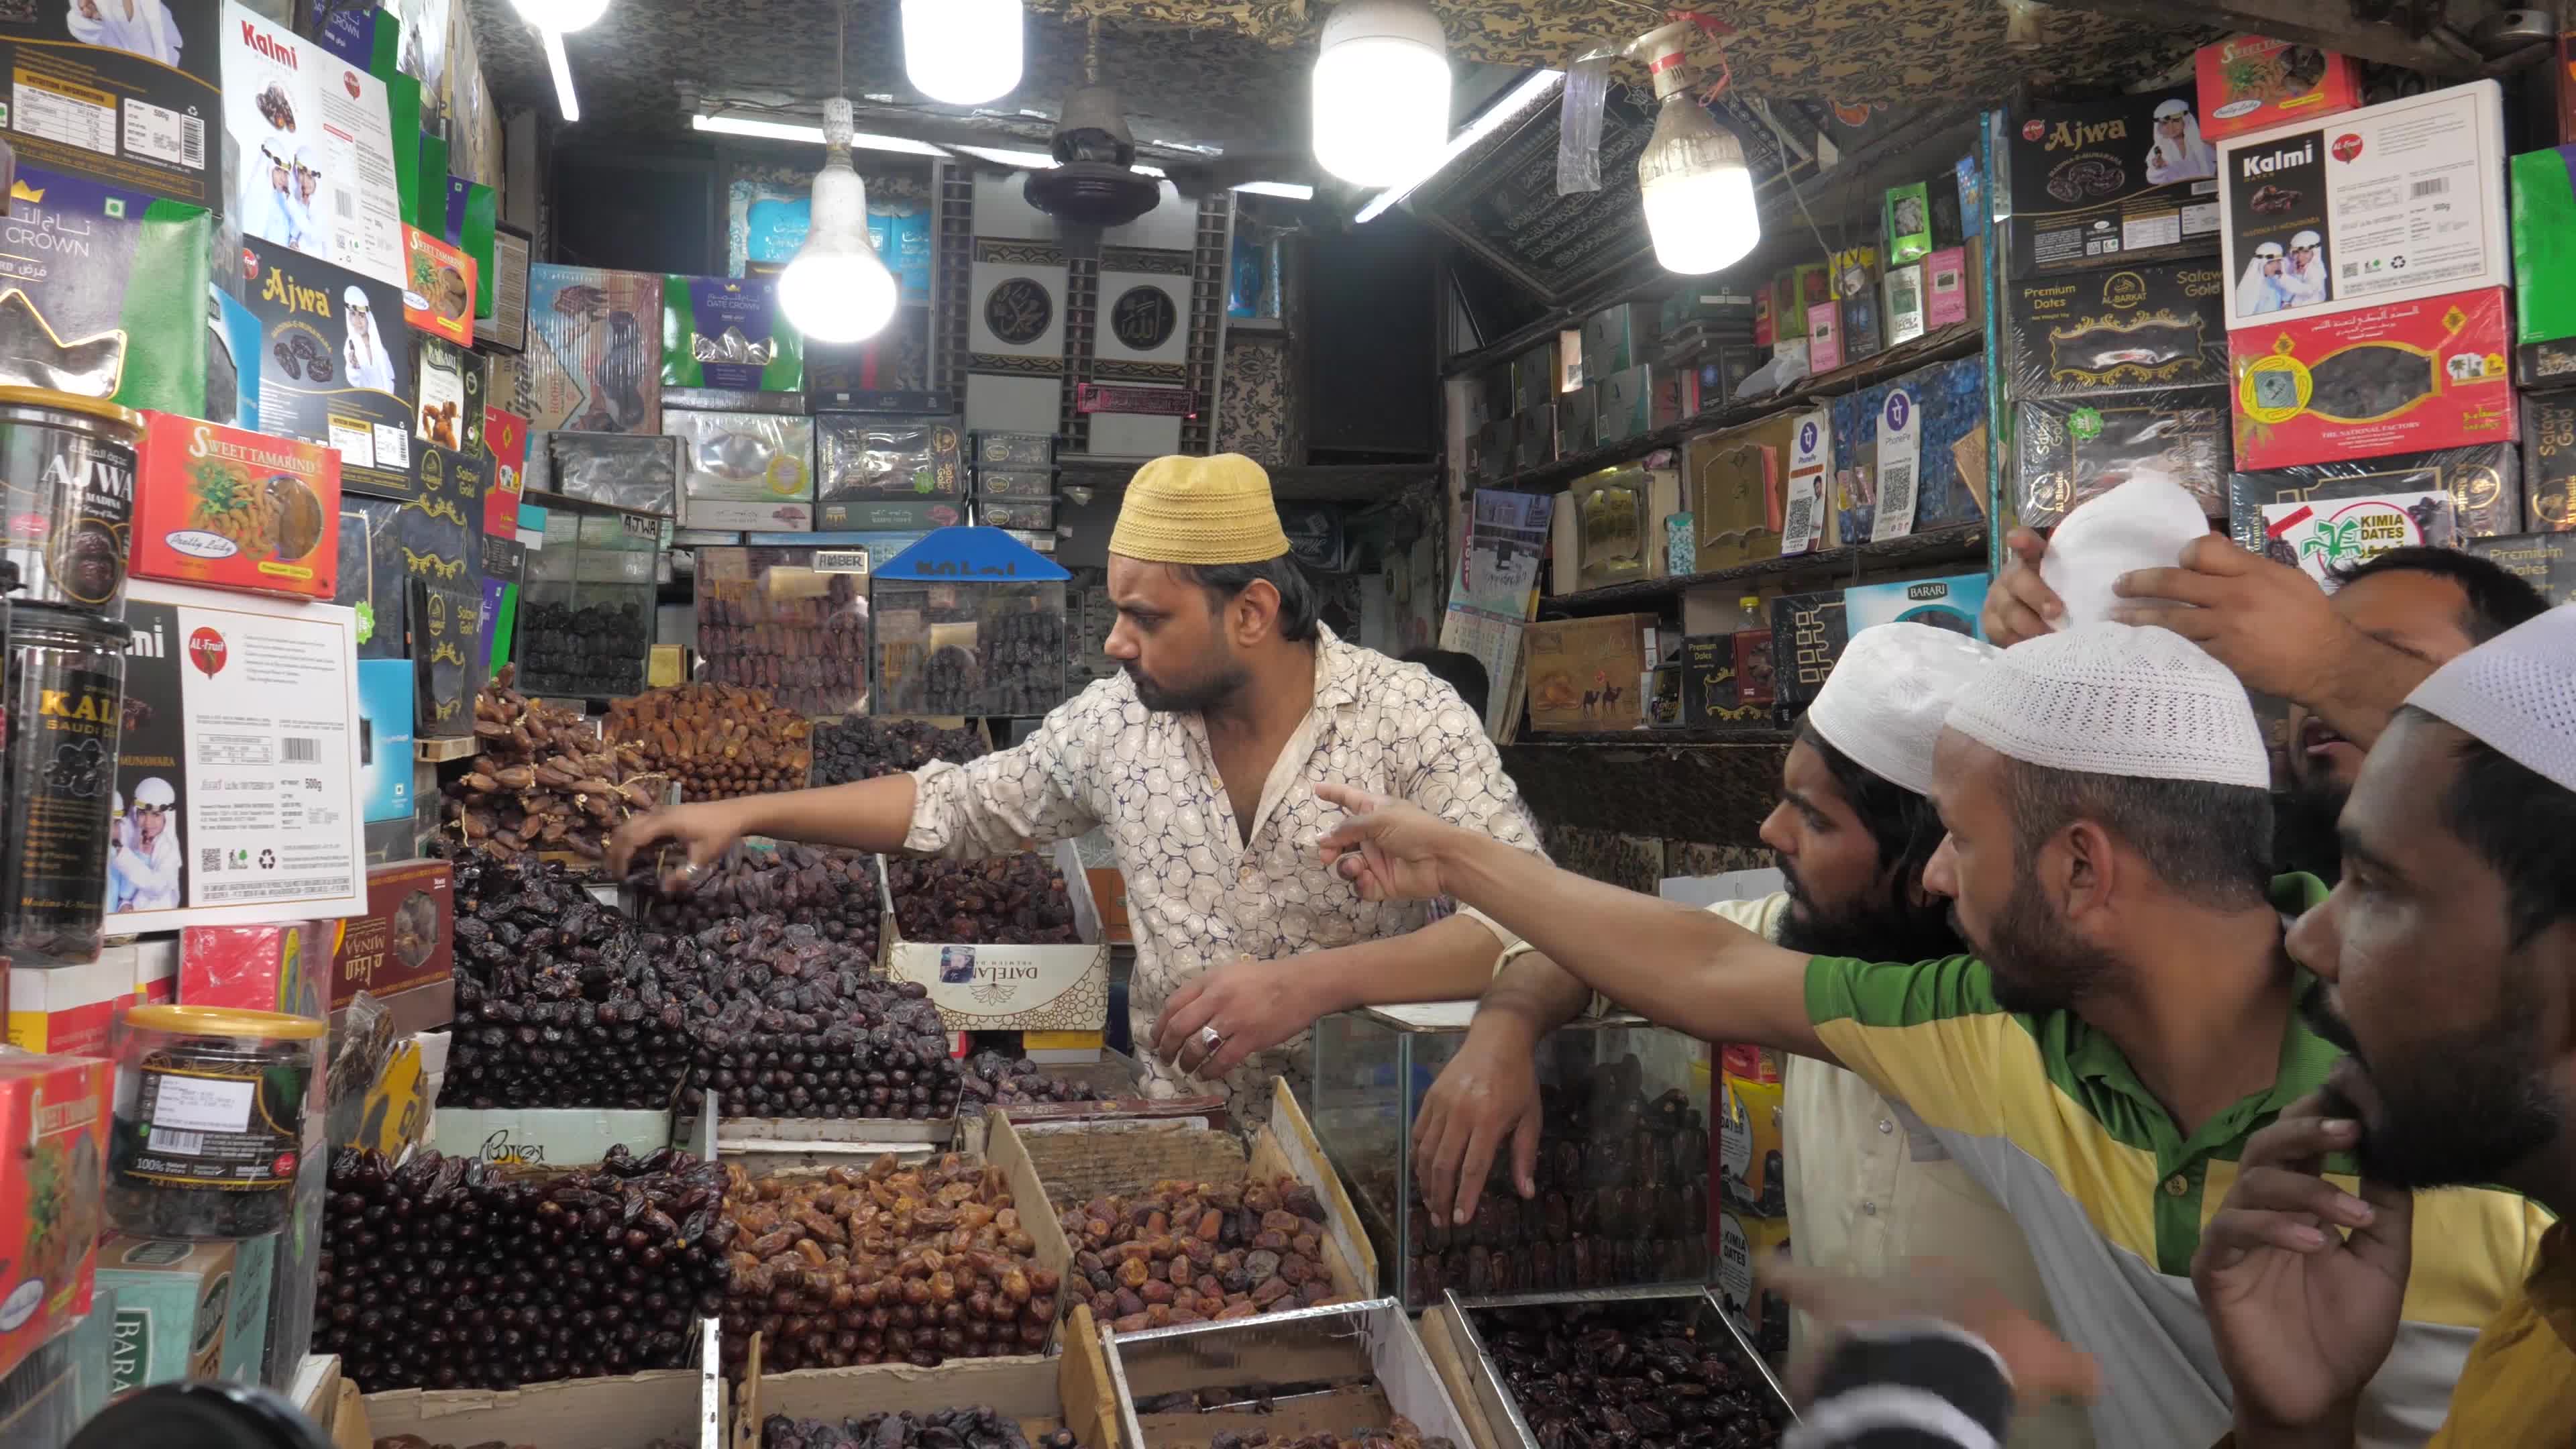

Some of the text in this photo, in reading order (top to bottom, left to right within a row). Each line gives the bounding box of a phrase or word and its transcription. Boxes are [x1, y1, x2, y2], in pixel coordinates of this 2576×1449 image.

[241, 19, 298, 70] Kalmi
[2044, 119, 2127, 152] Ajwa
[2243, 143, 2313, 177] Kalmi
[5, 226, 90, 258] CROWN
[2176, 270, 2222, 284] Salaw
[262, 266, 331, 319] Ajwa
[2024, 284, 2076, 298] Premium
[2102, 292, 2147, 305] AL-BARKAT
[2034, 298, 2067, 310] Dates
[2050, 415, 2064, 446] Gold
[1885, 433, 1911, 446] PhonePe
[189, 426, 316, 473] SWEET TAMARIND
[40, 453, 133, 502] AJWA
[623, 515, 656, 535] AJWA
[2361, 514, 2405, 528] KIMIA
[2361, 527, 2405, 541] DATES
[2489, 548, 2564, 561] Premium
[1910, 584, 1945, 598] BARARI
[190, 638, 225, 653] AL-Fruit
[1688, 643, 1717, 652] Premium
[305, 777, 322, 792] 500g
[137, 1157, 164, 1171] 100%
[1725, 1228, 1746, 1252] KIMIA
[1723, 1243, 1746, 1268] DATES
[111, 1320, 141, 1394] BARA
